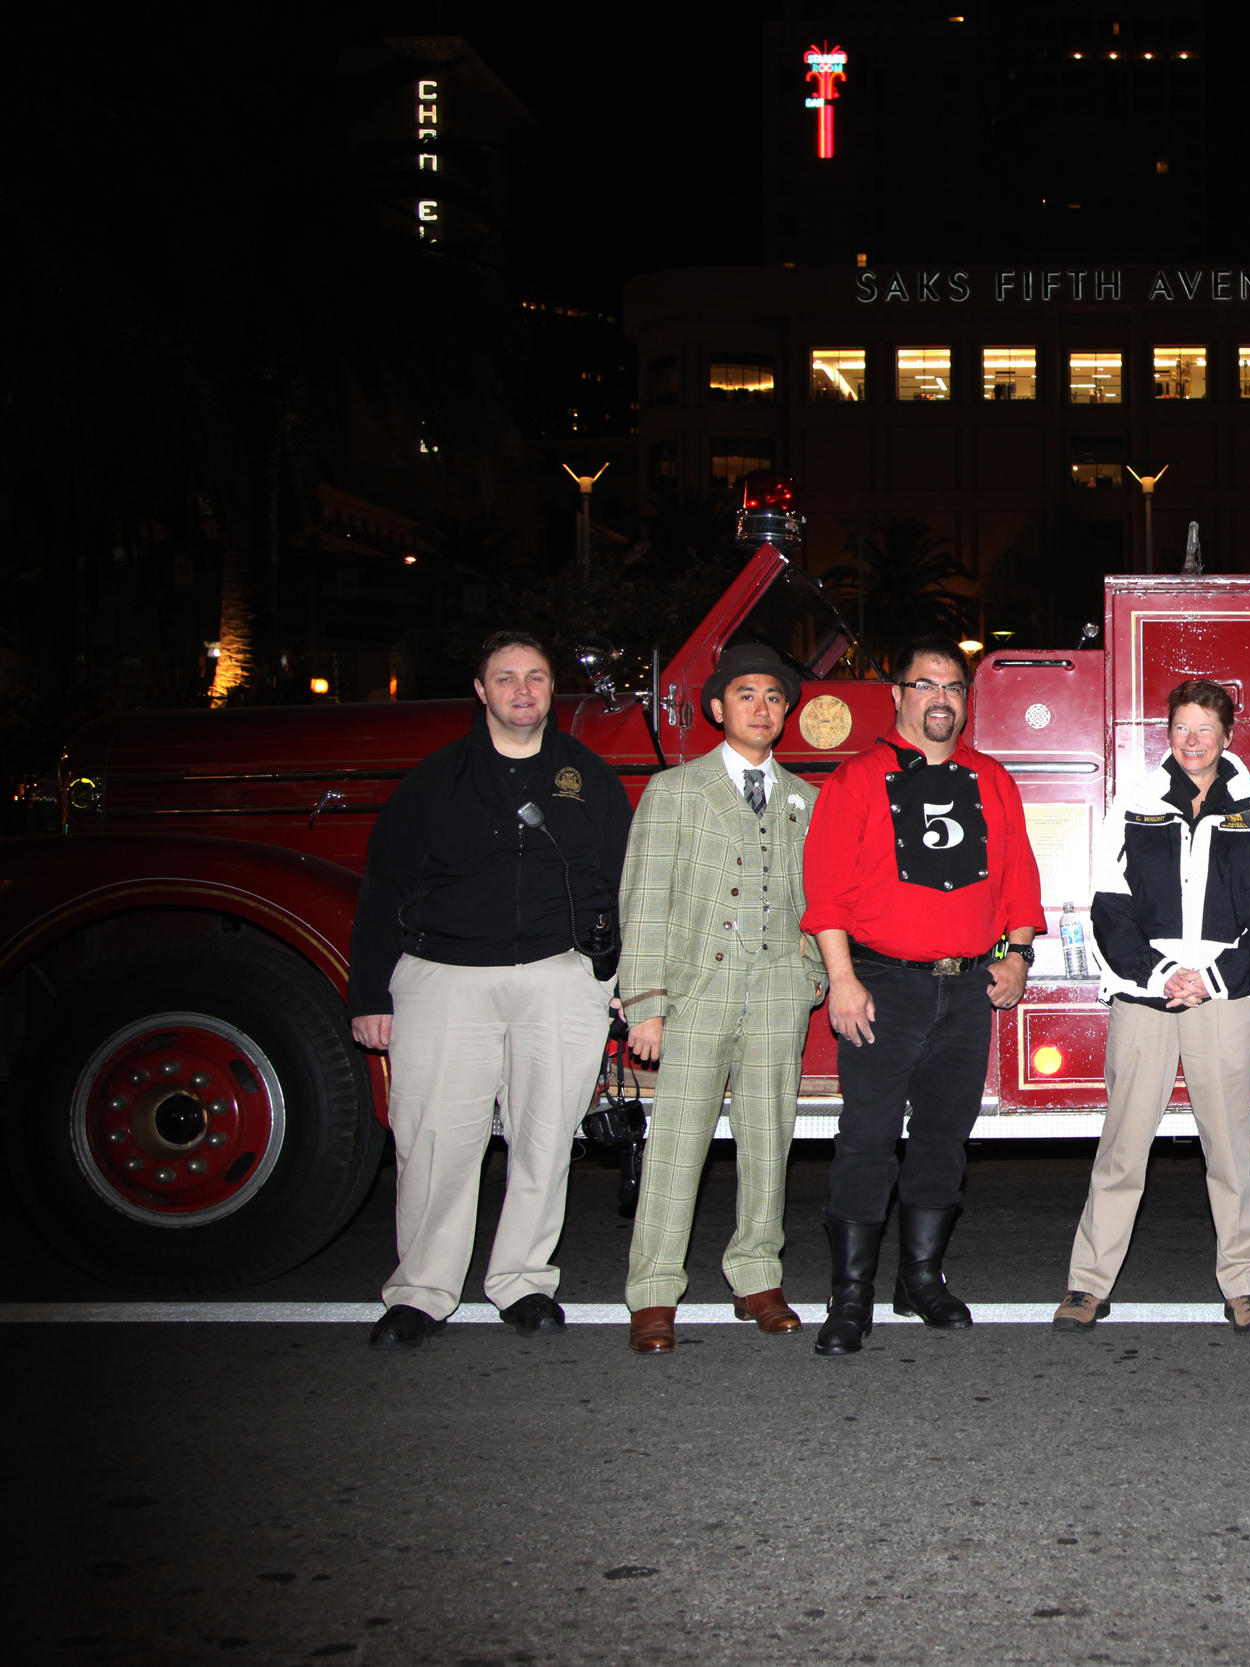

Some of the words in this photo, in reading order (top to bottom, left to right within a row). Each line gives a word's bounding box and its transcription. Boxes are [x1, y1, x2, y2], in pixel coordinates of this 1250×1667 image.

[812, 64, 843, 72] ROOM
[856, 271, 970, 302] SAKS
[996, 270, 1120, 300] FIFTH
[922, 800, 965, 850] 5
